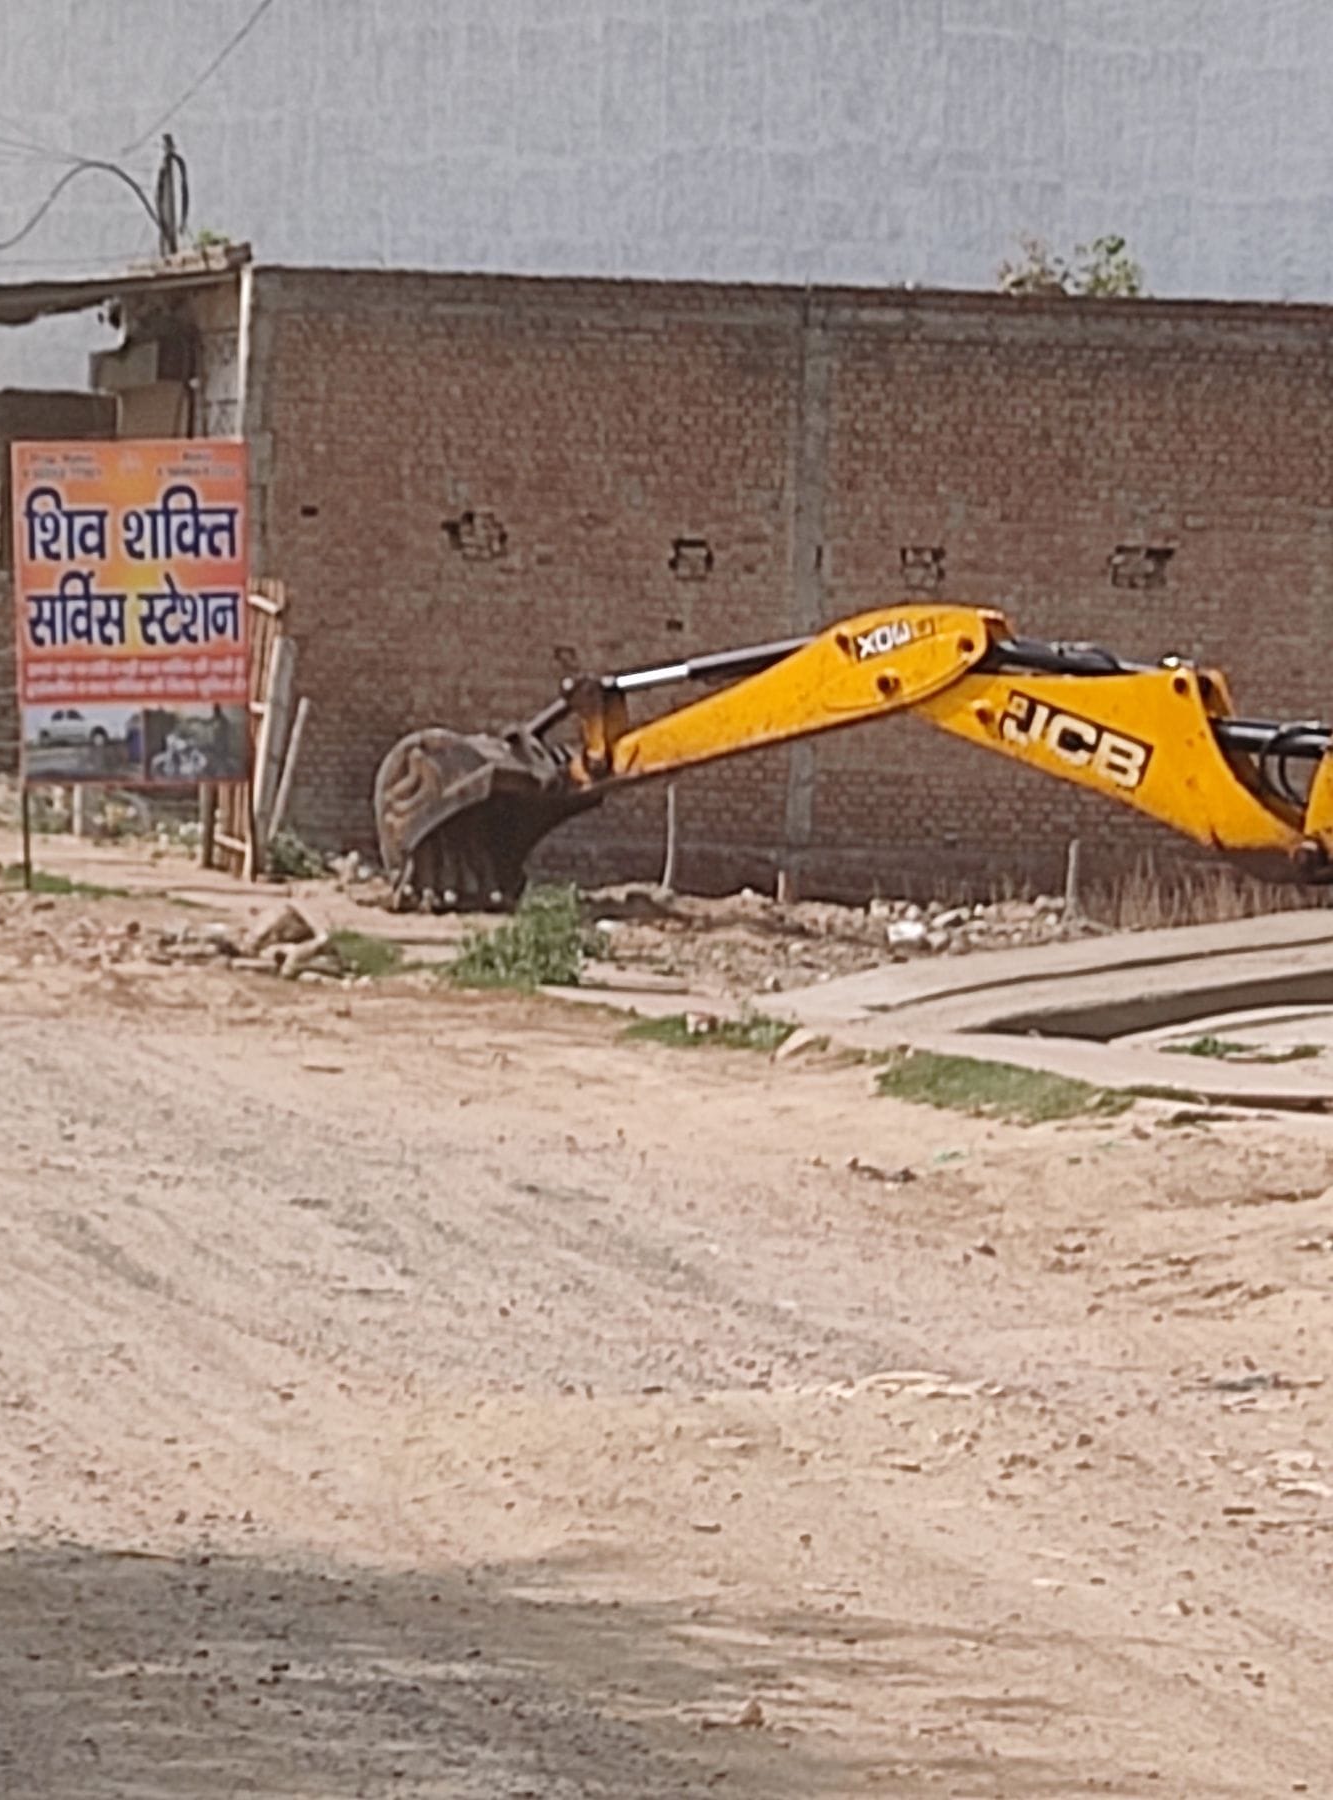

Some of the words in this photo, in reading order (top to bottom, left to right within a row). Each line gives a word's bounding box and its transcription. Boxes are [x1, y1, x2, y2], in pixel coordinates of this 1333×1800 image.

[24, 486, 108, 561] शिव
[122, 485, 239, 560] शक्ति
[26, 570, 127, 646] सर्विस
[137, 571, 241, 645] स्टेशन
[1001, 696, 1147, 788] JCB
